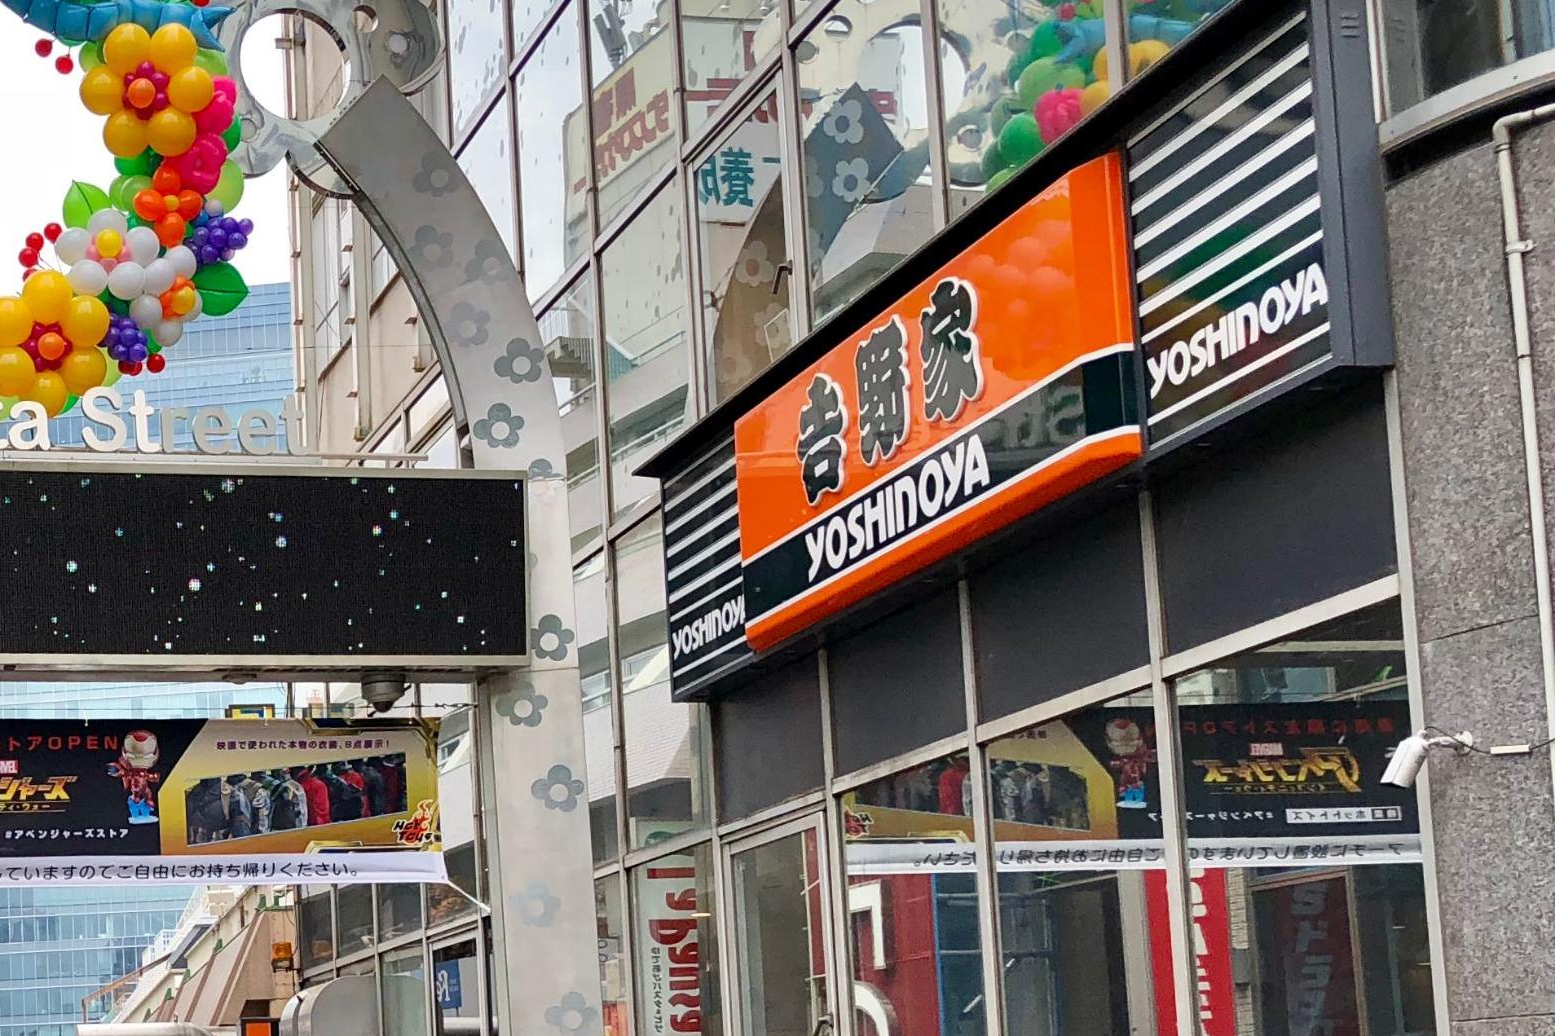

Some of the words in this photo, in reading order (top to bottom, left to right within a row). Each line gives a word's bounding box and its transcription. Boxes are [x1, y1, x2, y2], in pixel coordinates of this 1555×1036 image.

[797, 277, 984, 506] 吉野家
[1148, 262, 1329, 398] YOSHINOYA
[82, 384, 309, 457] Street
[805, 434, 991, 581] YOSHINOYA
